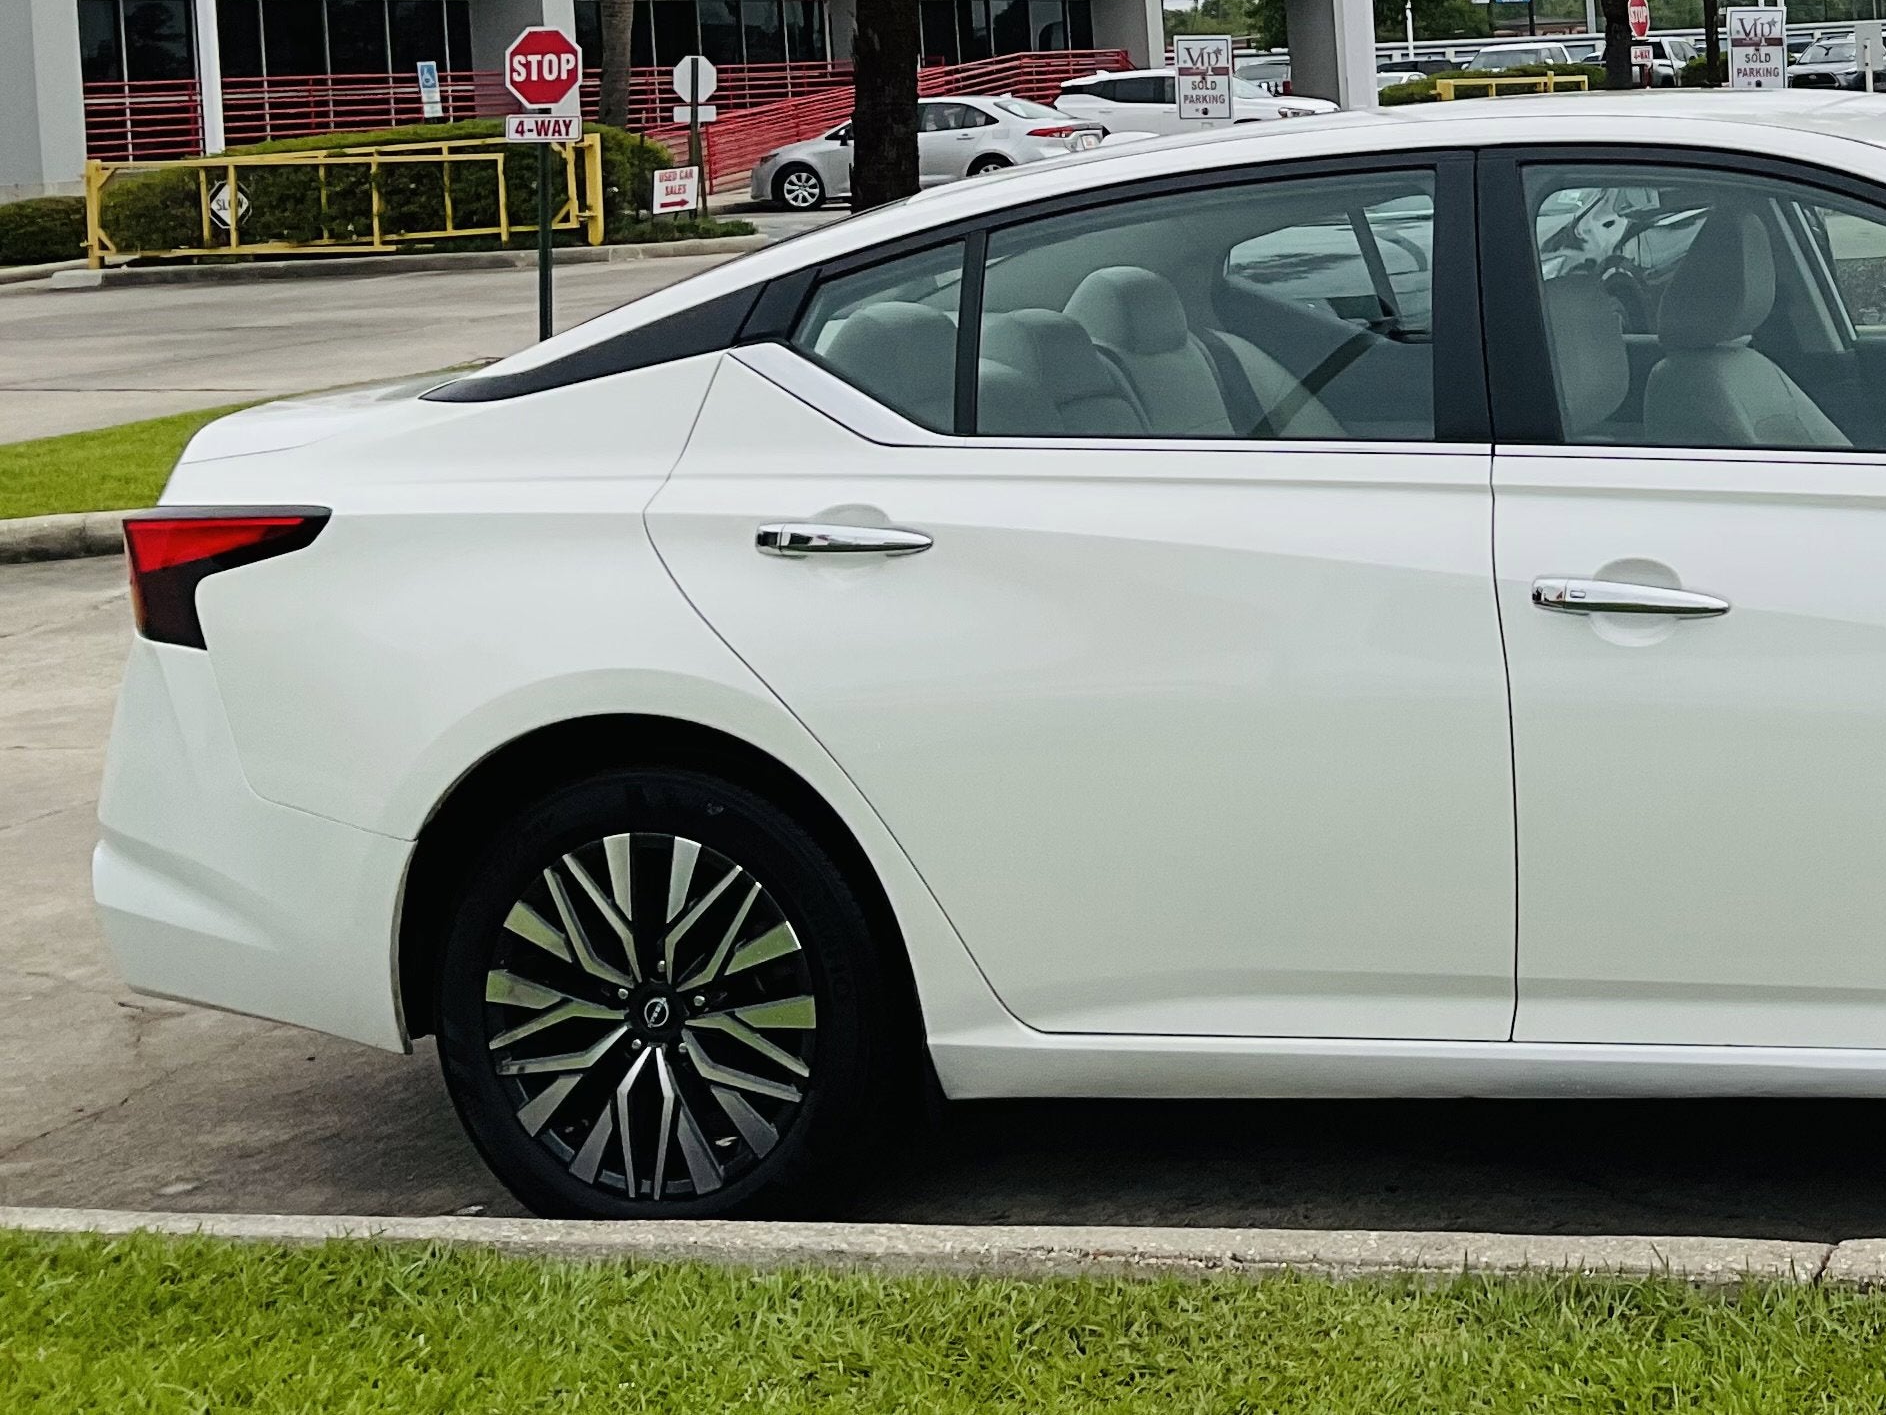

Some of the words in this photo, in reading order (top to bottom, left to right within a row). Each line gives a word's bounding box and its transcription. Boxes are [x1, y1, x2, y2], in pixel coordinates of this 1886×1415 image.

[1630, 6, 1648, 23] STOP
[1745, 53, 1771, 63] SOLD
[512, 53, 576, 82] STOP
[1737, 67, 1779, 78] PARKING
[1191, 81, 1217, 90] SOLD
[1183, 94, 1225, 104] PARKING
[515, 119, 573, 137] 4-WAY
[659, 171, 677, 182] USED
[680, 169, 693, 180] CAR
[665, 184, 687, 196] SALES
